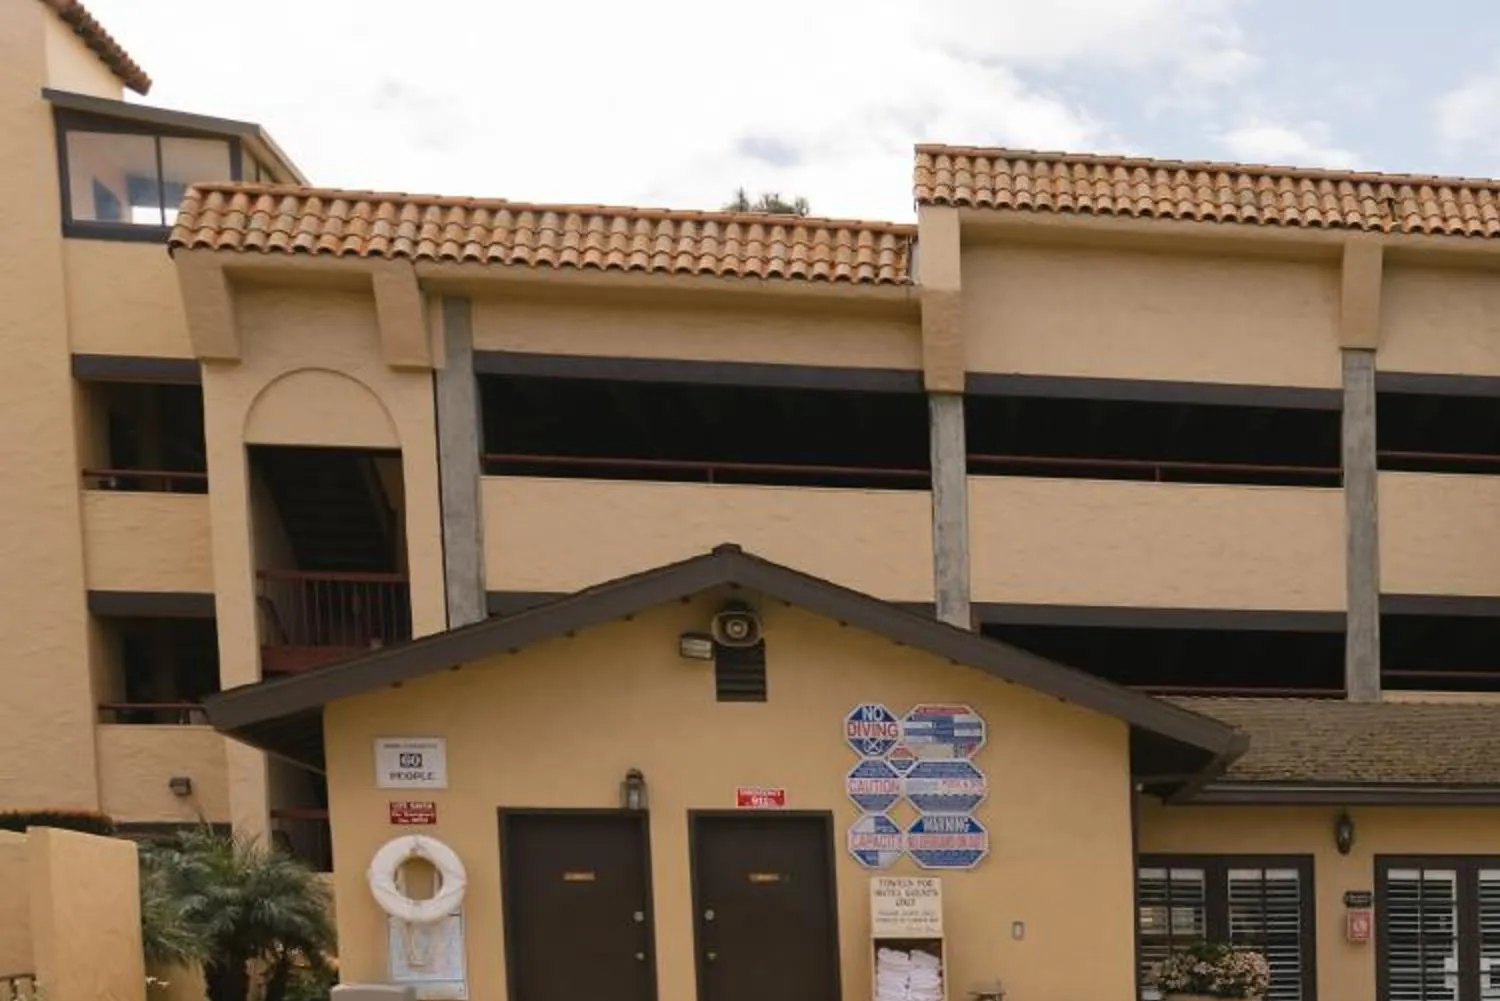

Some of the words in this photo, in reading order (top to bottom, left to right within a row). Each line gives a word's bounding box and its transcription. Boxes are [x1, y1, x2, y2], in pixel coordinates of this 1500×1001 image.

[861, 705, 884, 721] NO
[847, 722, 899, 737] DIVING
[848, 779, 900, 794] CAUTION
[922, 816, 971, 833] WARNING
[917, 879, 933, 888] FOR
